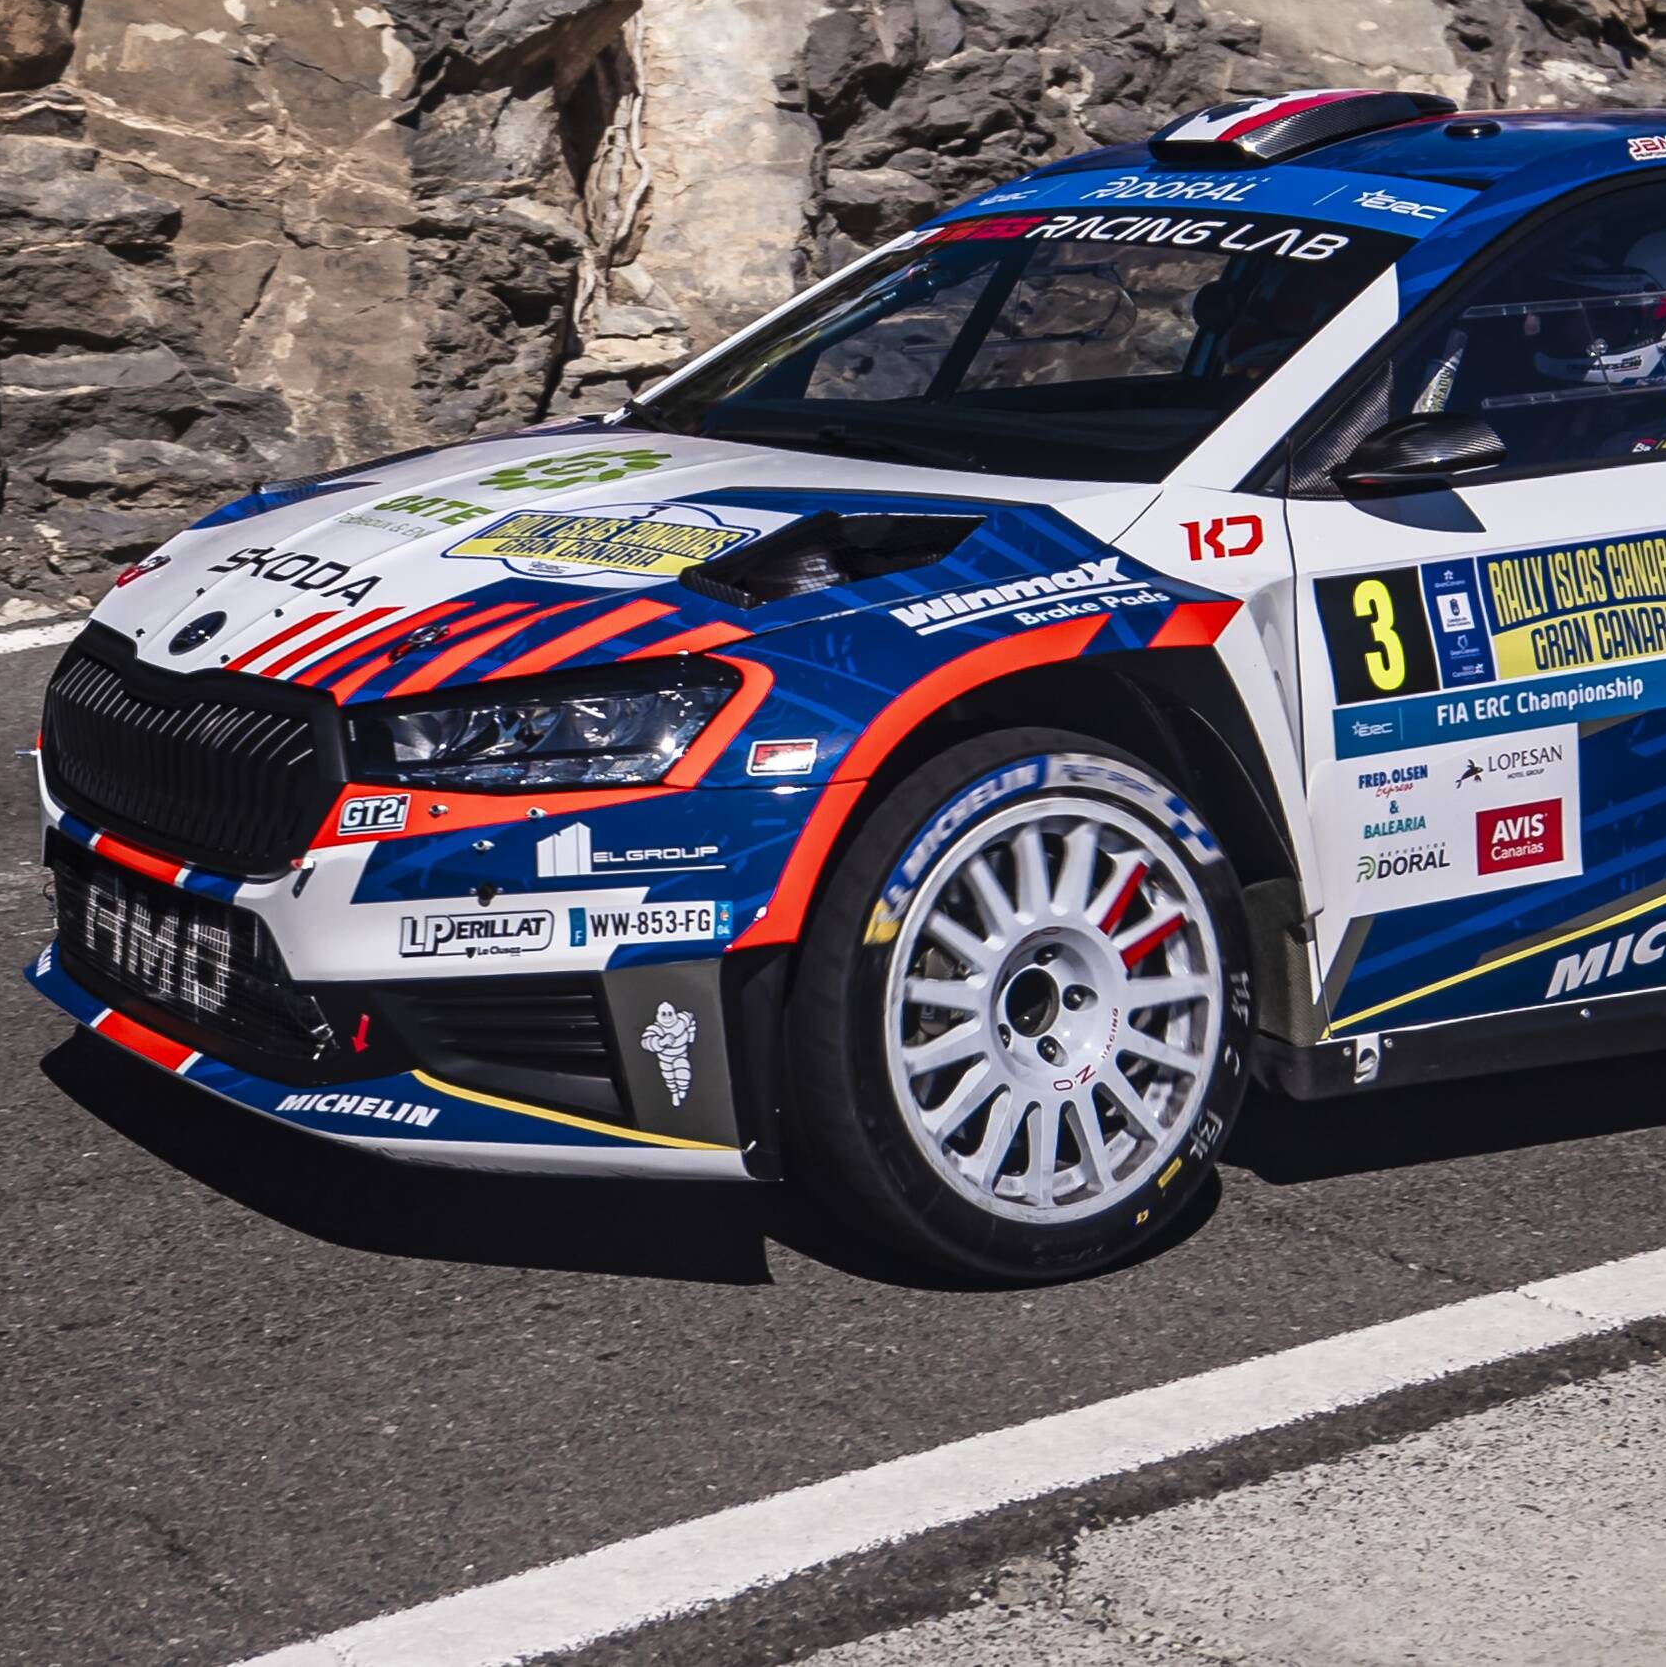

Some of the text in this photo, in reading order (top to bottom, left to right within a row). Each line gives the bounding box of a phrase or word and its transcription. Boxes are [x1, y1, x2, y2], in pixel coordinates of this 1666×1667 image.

[1025, 216, 1225, 245] RACING
[1229, 222, 1350, 261] LAB
[492, 538, 558, 555] GRAN
[555, 540, 664, 568] CANARIA
[1488, 555, 1548, 627] RALLY
[1547, 546, 1608, 611] ISLAS
[1013, 590, 1171, 626] Brake Pads
[1352, 579, 1407, 692] 3
[1531, 618, 1593, 671] GRAN
[1436, 676, 1644, 727] FIA ERC Championship
[1488, 745, 1564, 773] LOPESAN
[1507, 768, 1546, 780] HOTEL GROUP
[342, 795, 409, 829] GT2i
[1389, 800, 1400, 814] &
[1491, 814, 1546, 844] AVIS
[1377, 849, 1451, 880] DORAL
[1490, 841, 1545, 862] Canarias
[573, 930, 583, 945] F
[589, 909, 712, 938] WW-853-FG
[274, 1093, 441, 1128] MICHELIN
